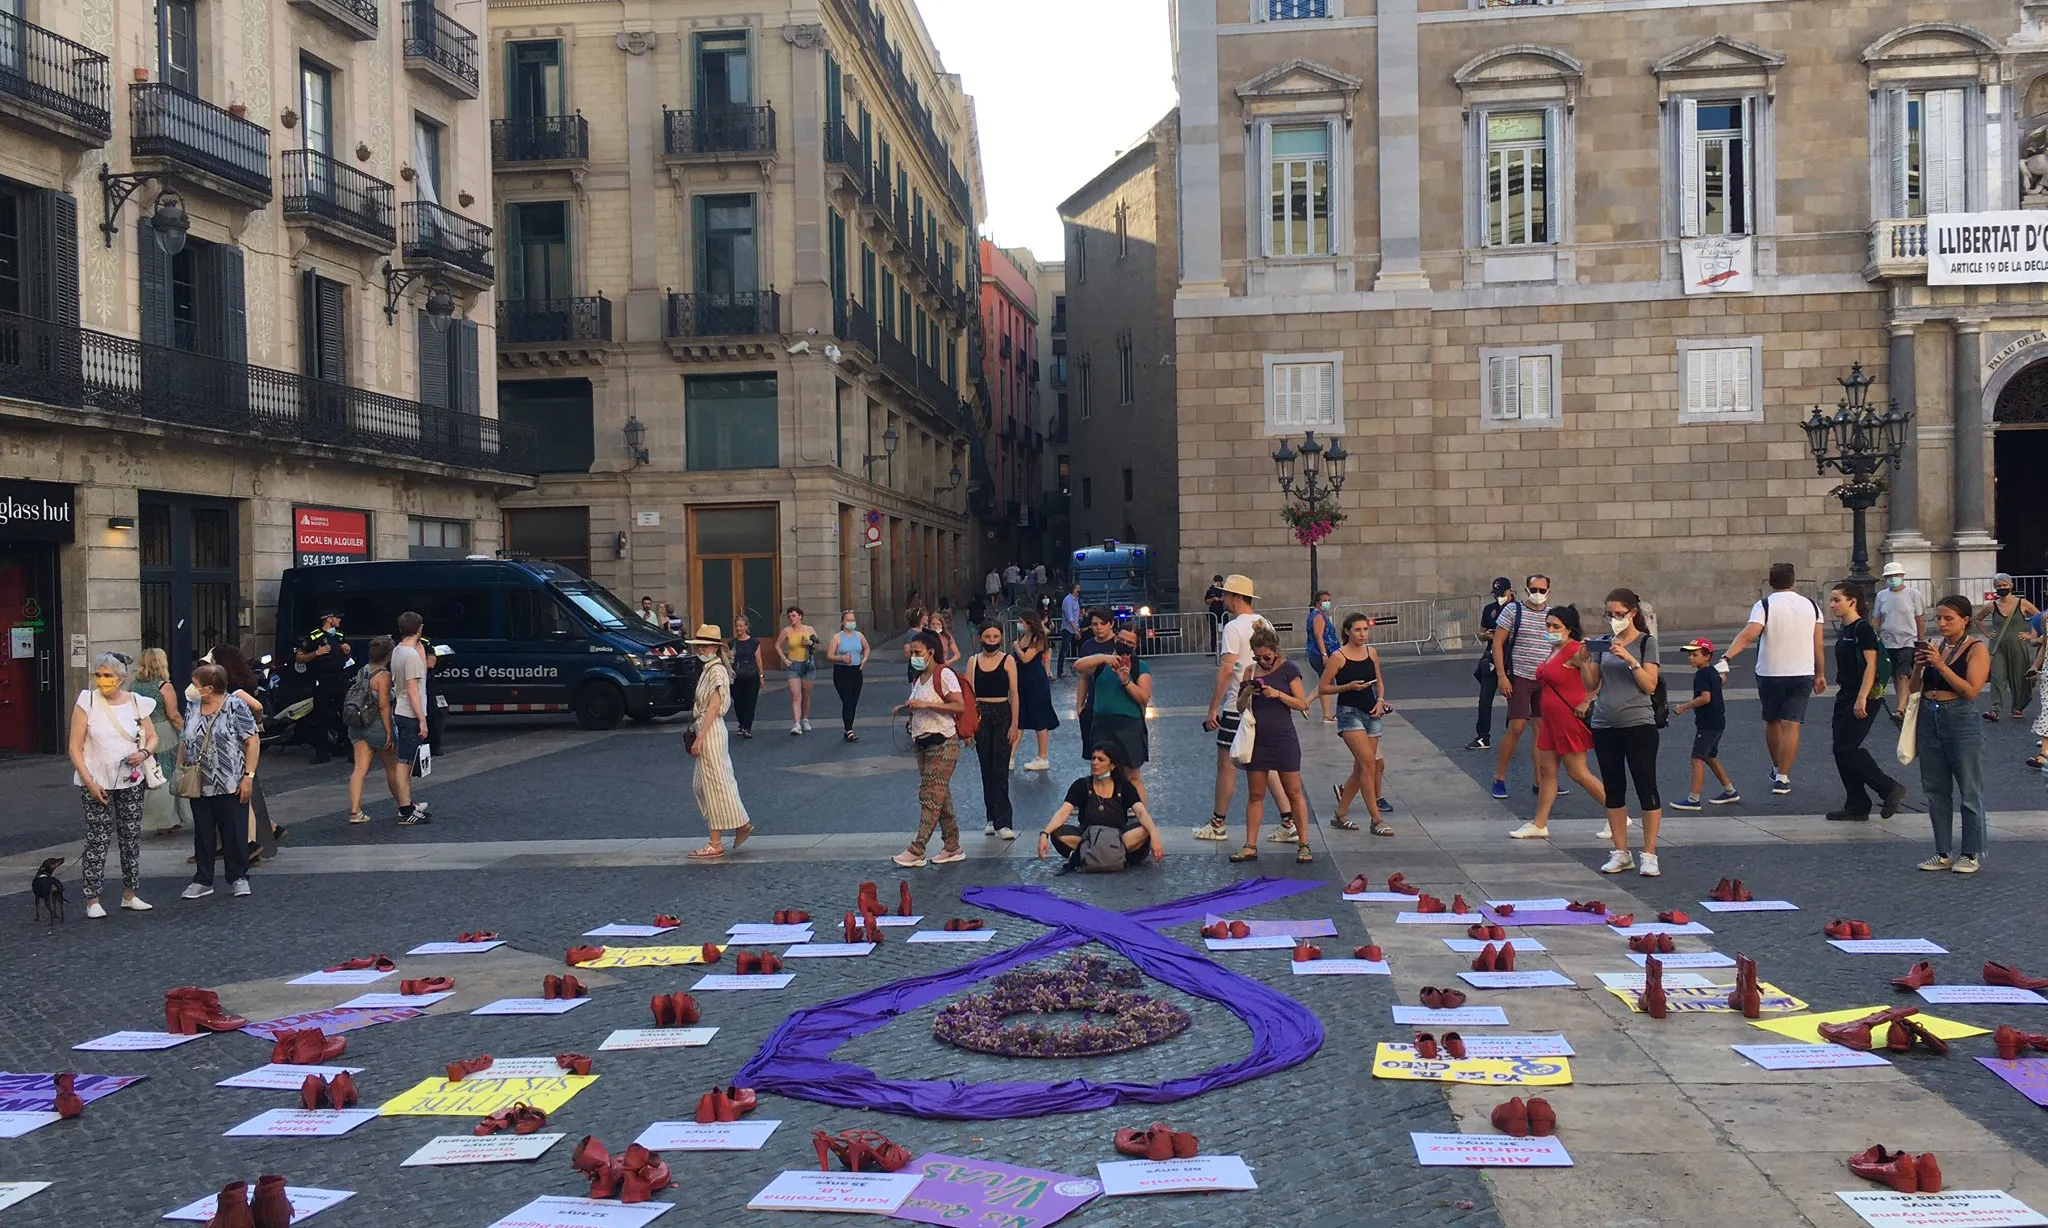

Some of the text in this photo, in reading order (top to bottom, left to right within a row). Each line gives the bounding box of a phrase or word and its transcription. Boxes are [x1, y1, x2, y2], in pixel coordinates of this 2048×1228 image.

[1939, 225, 2020, 254] LLIBERTAT
[1951, 262, 1982, 273] ARTICLE
[1985, 262, 1996, 273] 19
[1998, 261, 2009, 272] DE
[2011, 261, 2022, 272] LA
[1988, 332, 2047, 370] PALAU DE LA
[0, 496, 70, 525] glass hut
[300, 536, 364, 547] LOCAL EN ALQUILER
[302, 555, 320, 566] 934
[474, 665, 558, 680] d'esquadra
[1381, 1061, 1451, 1071] CREO
[1465, 1156, 1531, 1164] Alicia
[1139, 1176, 1218, 1186] Antonia
[763, 1194, 890, 1204] Katia Carolina
[1917, 1194, 2002, 1202] Roquetas
[1869, 1210, 1925, 1218] Oyana
[1905, 1216, 2011, 1225] Inmaculada
